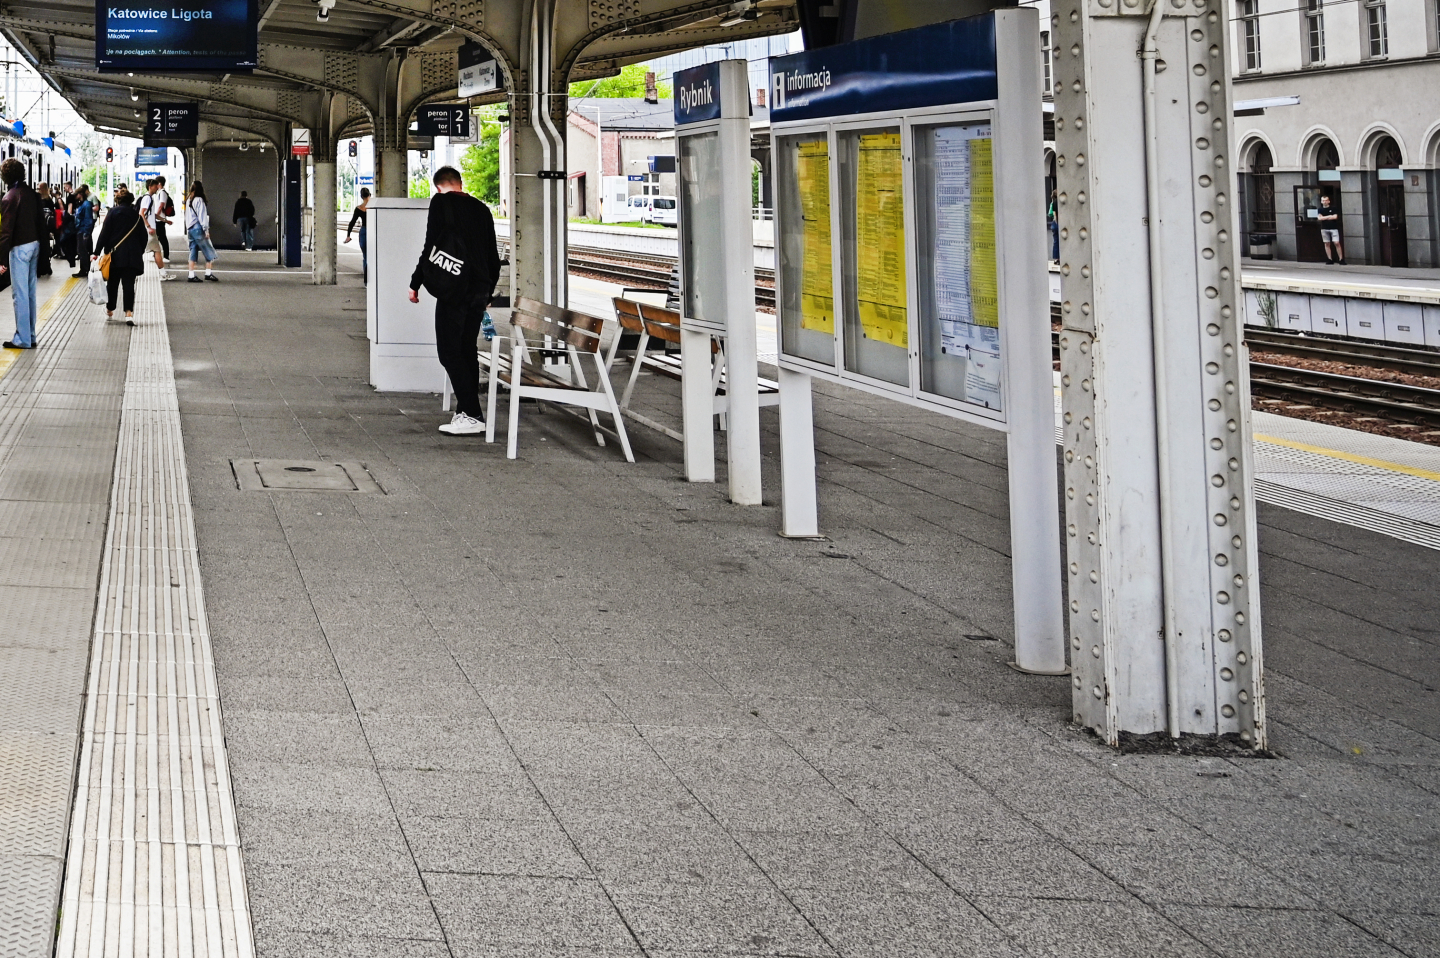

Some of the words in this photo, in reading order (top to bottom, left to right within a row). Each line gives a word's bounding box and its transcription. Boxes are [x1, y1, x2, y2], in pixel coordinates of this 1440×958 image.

[108, 8, 168, 19] Katowice
[172, 8, 212, 21] Ligota
[787, 65, 831, 93] informacja
[680, 79, 713, 115] Rybnik
[153, 108, 161, 120] 2
[455, 110, 464, 122] 2
[154, 122, 162, 132] 2
[456, 123, 462, 134] 1
[428, 245, 464, 276] VANS
